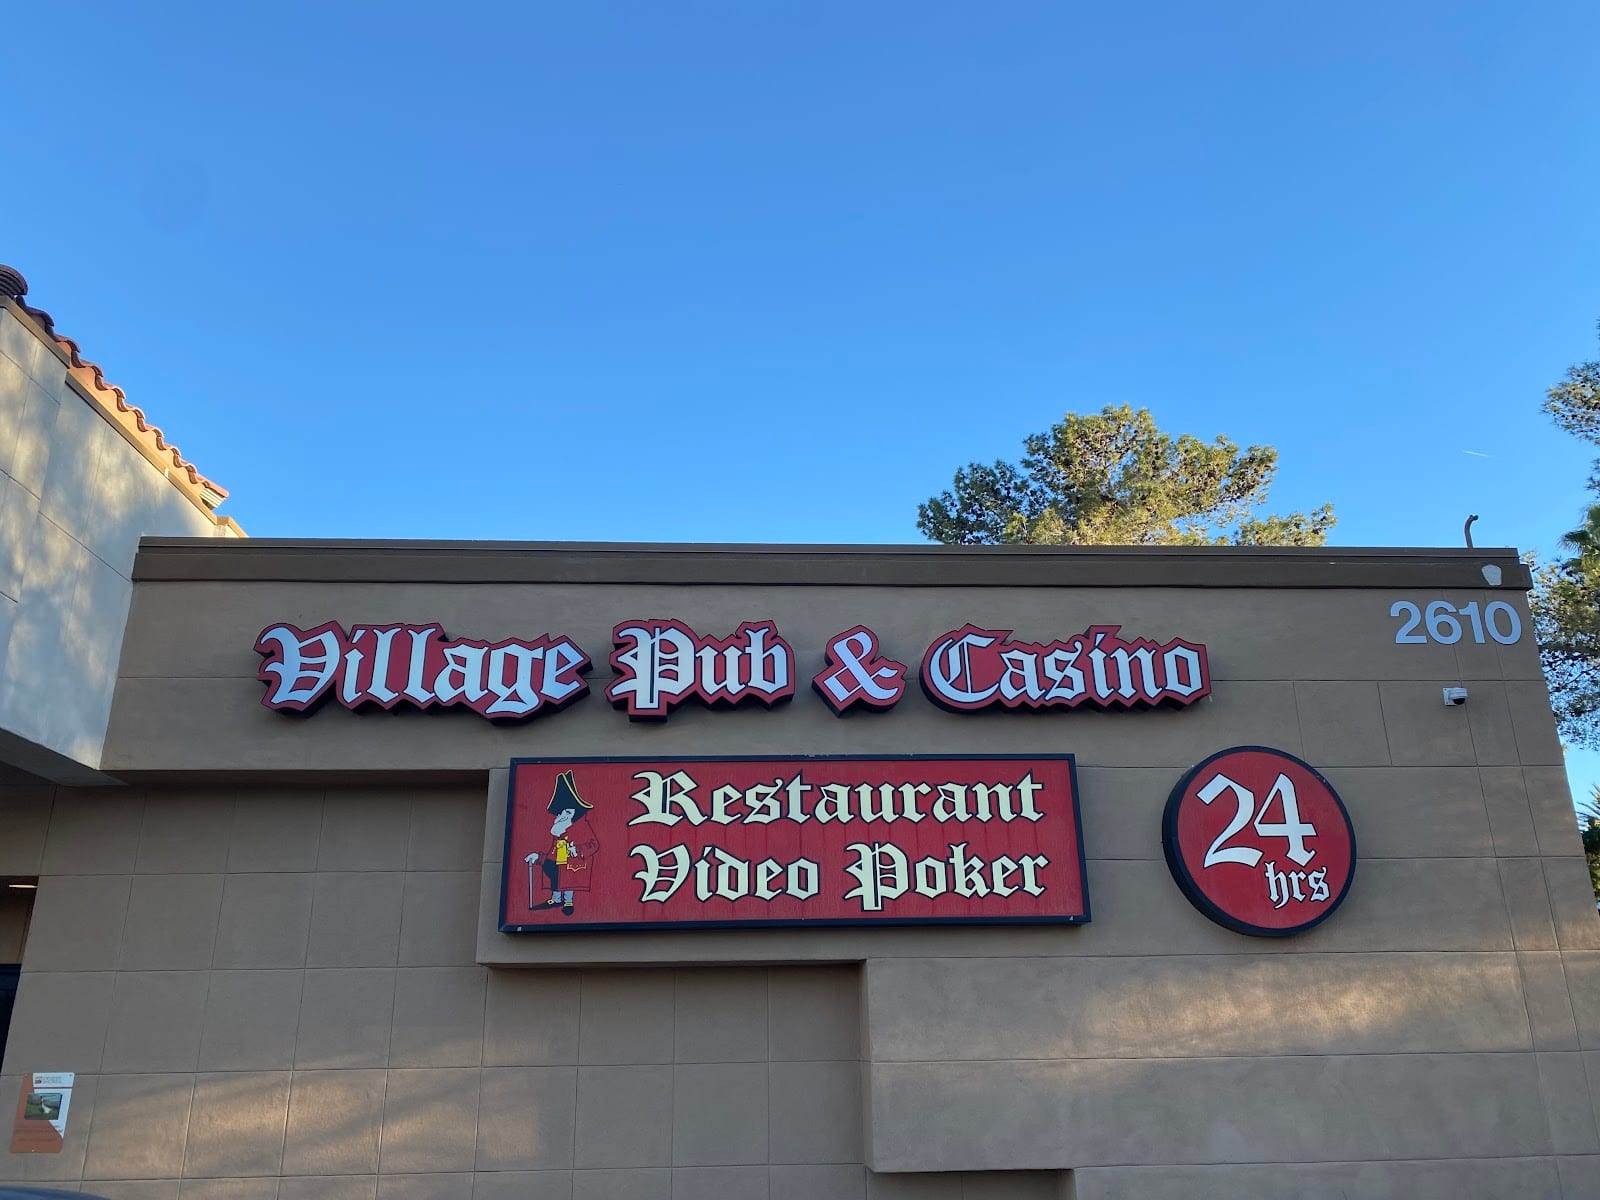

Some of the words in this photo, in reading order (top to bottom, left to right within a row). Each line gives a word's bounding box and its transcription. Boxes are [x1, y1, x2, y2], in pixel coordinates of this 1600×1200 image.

[1390, 600, 1522, 645] 2610
[261, 626, 585, 715] Village
[617, 626, 792, 709] Pub
[823, 630, 899, 703] &
[930, 633, 1202, 702] Casino
[628, 769, 1044, 827] Restaurant
[1196, 773, 1317, 868] 24
[629, 842, 819, 902] Video
[844, 841, 1050, 912] Poker
[1264, 861, 1331, 909] hrs
